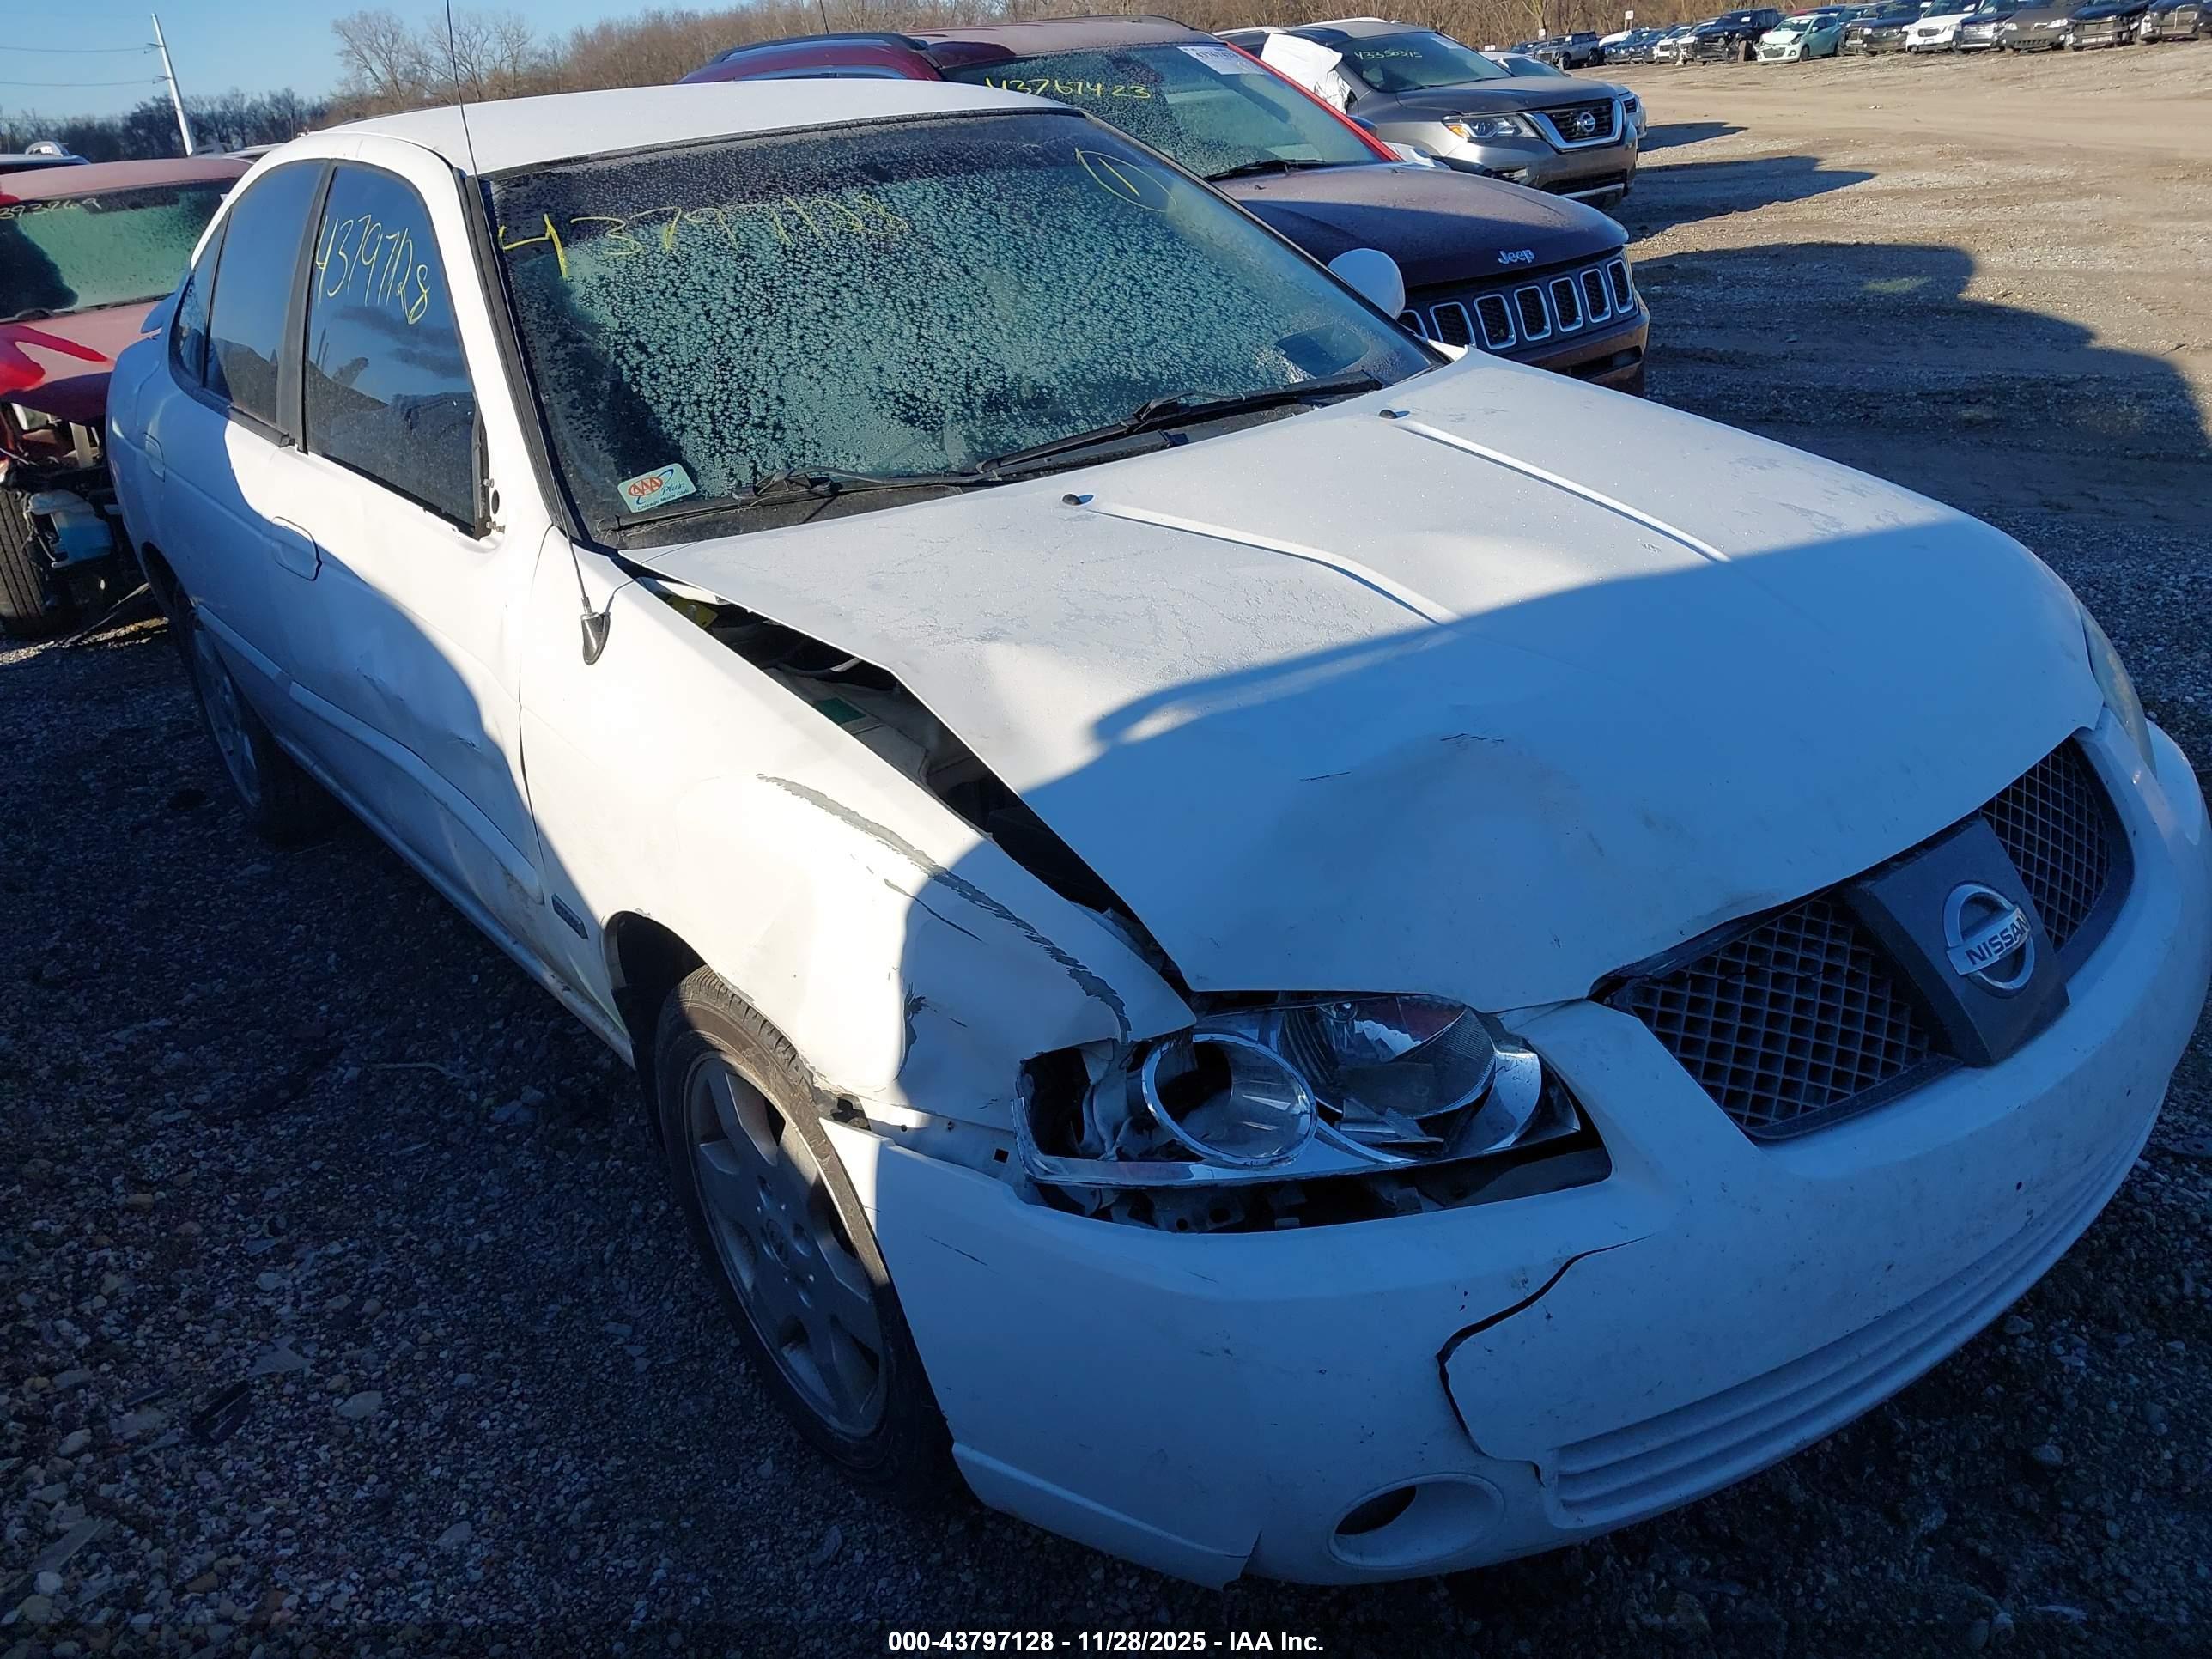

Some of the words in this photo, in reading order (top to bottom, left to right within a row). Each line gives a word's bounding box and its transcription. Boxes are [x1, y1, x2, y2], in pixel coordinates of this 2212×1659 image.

[1498, 249, 1535, 264] Jeep
[629, 477, 662, 496] AAA
[1965, 913, 2030, 966] NISSAN
